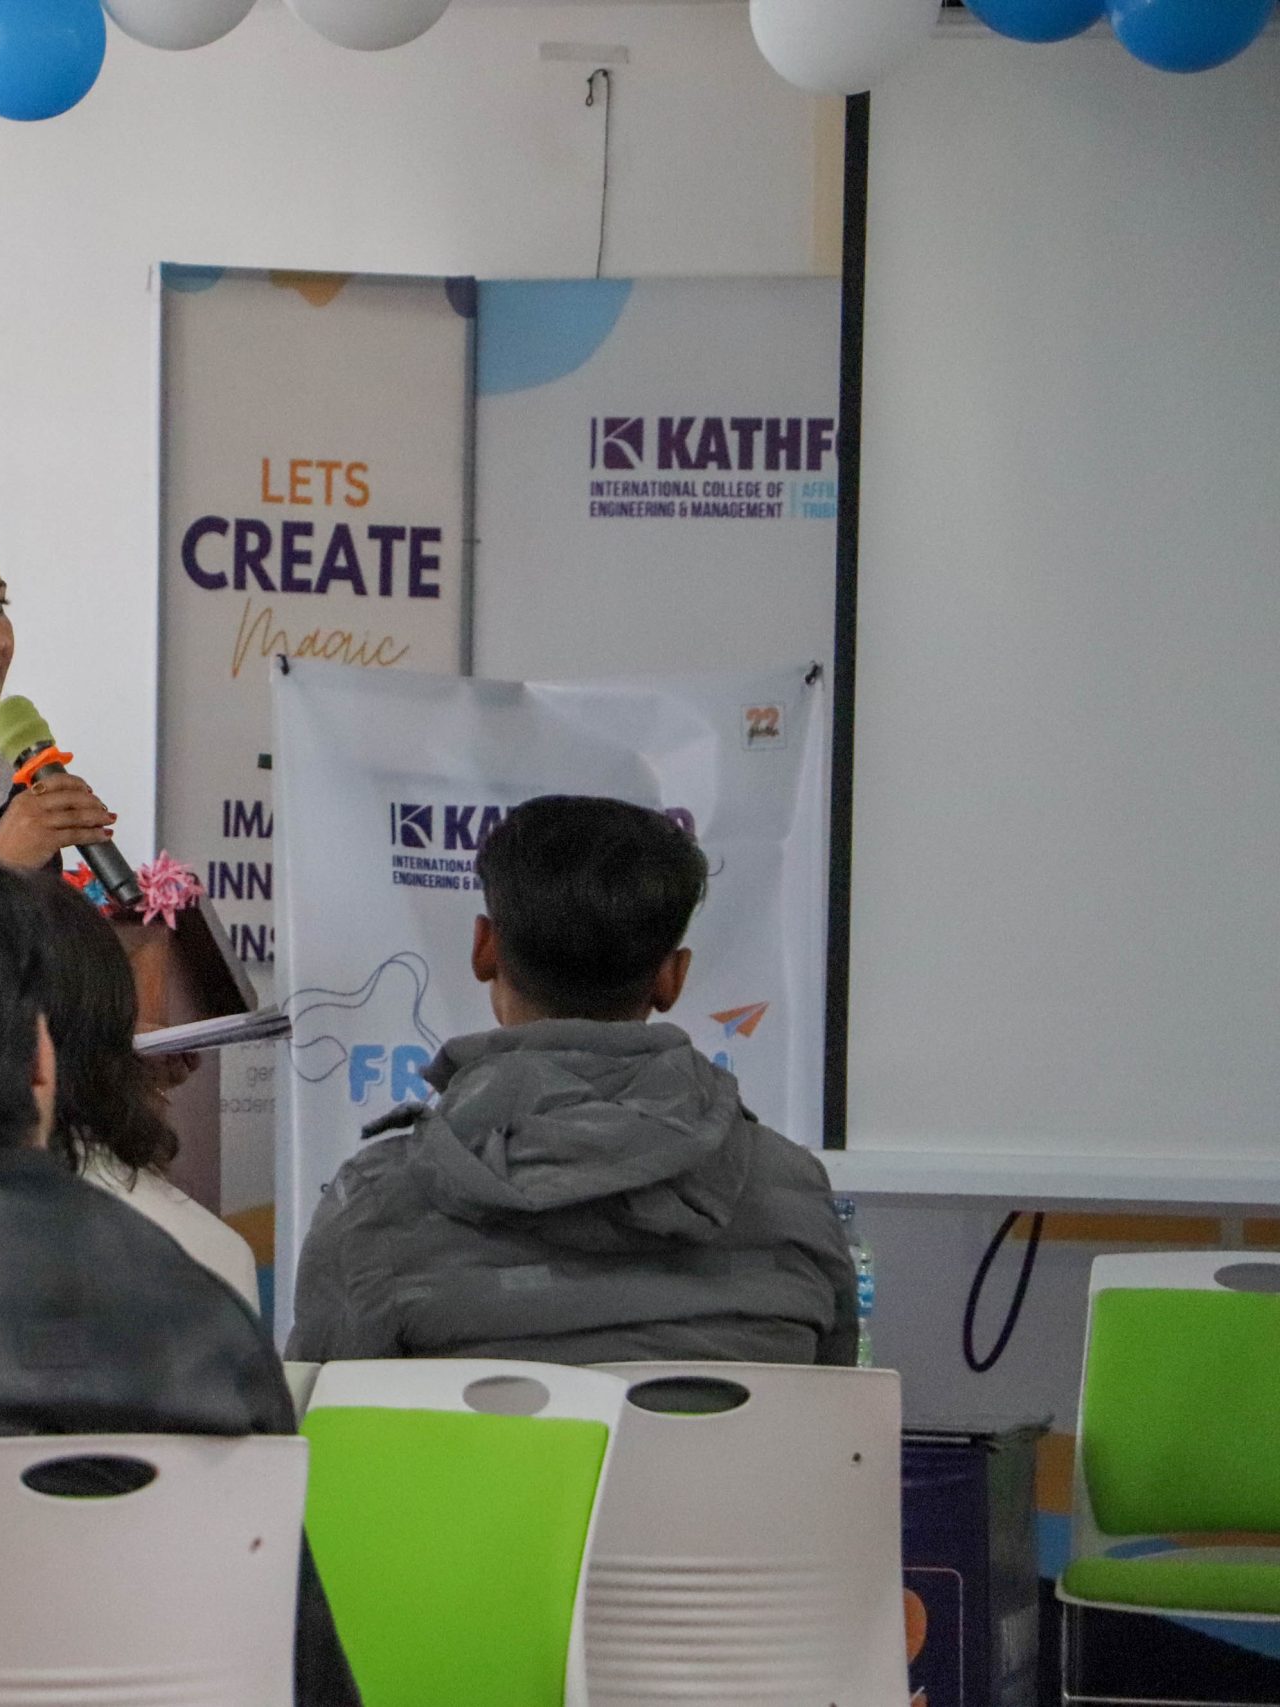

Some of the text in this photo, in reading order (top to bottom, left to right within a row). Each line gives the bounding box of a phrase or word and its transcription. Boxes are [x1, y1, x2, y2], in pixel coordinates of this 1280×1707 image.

[657, 417, 838, 471] KATHF
[261, 457, 369, 508] LETS
[590, 481, 784, 498] INTERNATIONAL COLLEGE OF
[590, 502, 783, 518] ENGINEERING & MANAGEMENT
[181, 515, 442, 599] CREATE
[393, 870, 460, 889] ENGINEERING
